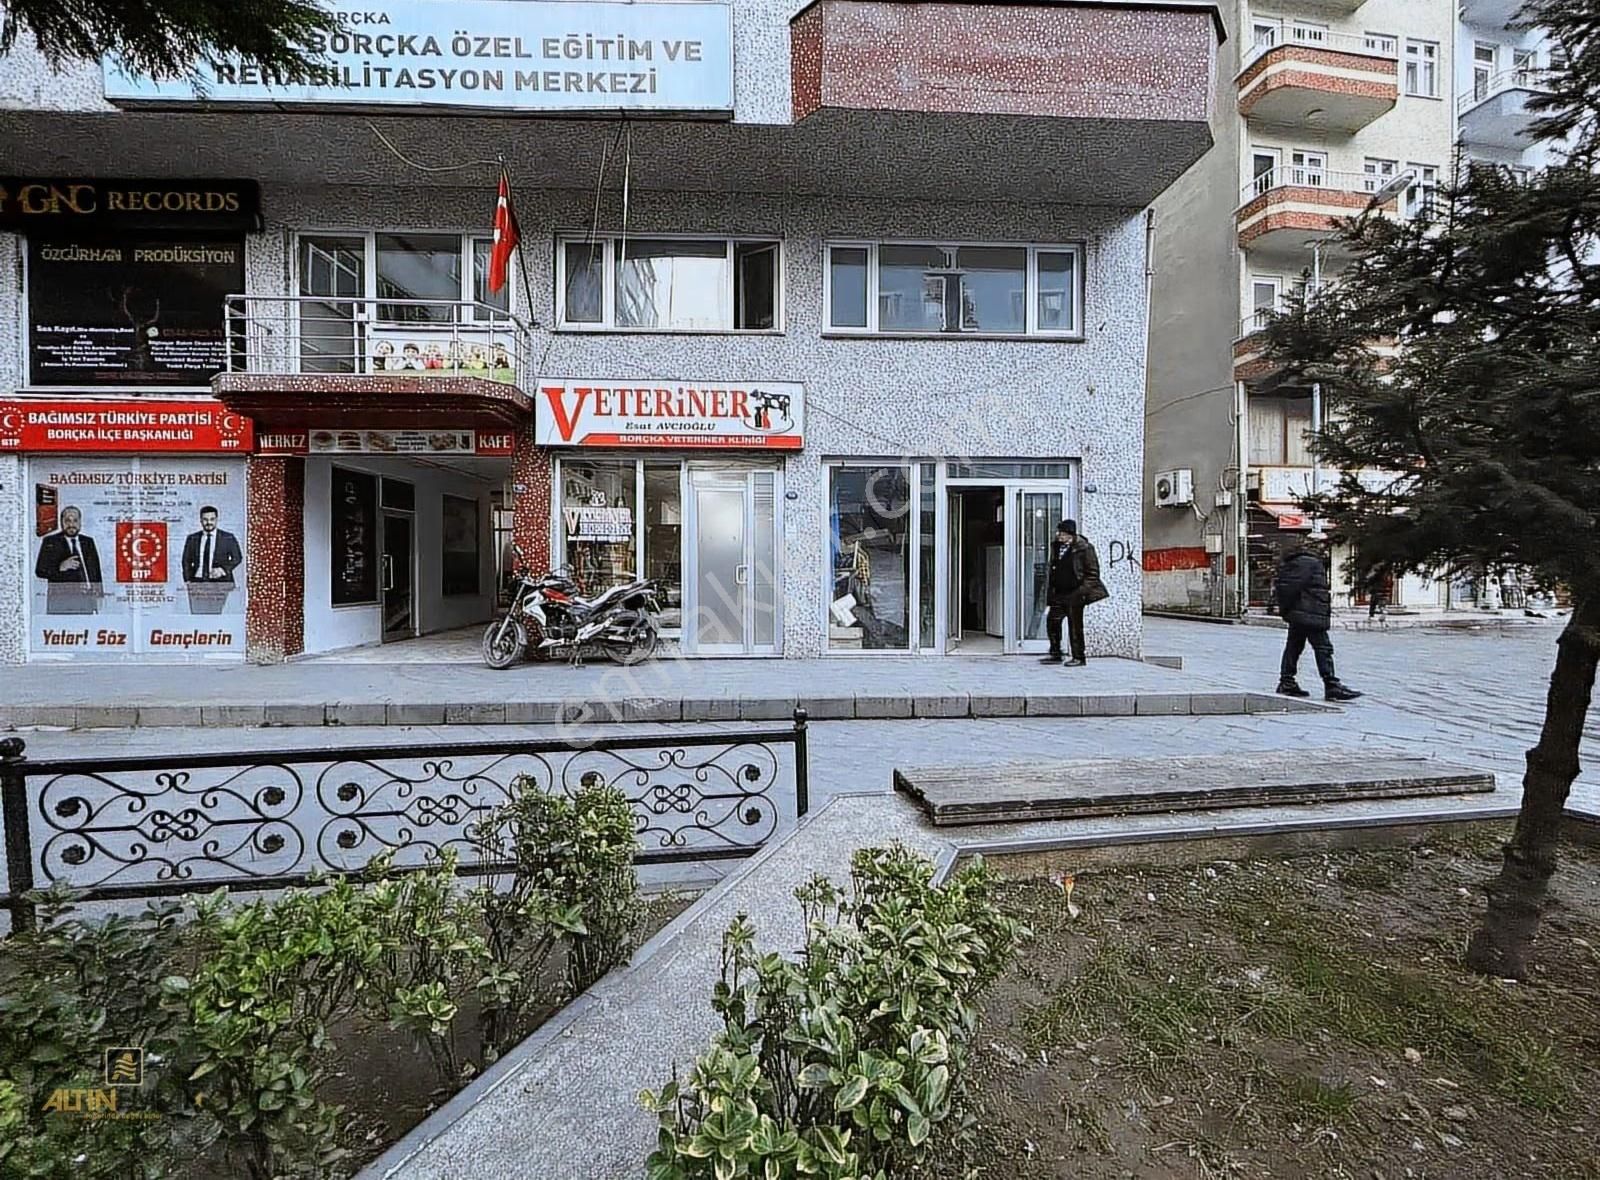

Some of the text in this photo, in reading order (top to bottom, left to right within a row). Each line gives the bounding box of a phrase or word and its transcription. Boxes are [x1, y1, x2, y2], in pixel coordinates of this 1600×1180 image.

[308, 30, 702, 61] BORÇKA ÖZEL EĞİTİM VE
[514, 68, 657, 94] MERKEZİ
[107, 191, 240, 211] RECORDS
[41, 244, 235, 263] ÖZGÜRHAN PRODÜKSİYON
[28, 410, 212, 425] BAĞIMSIZ TÜRKİYE PARTİSİ
[656, 421, 716, 431] AVCIOĞLU
[47, 427, 193, 442] BORÇKA İLÇE BAŞKANLIĞI
[479, 434, 511, 449] KAFE
[49, 471, 227, 485] BAĞIMSIZ TÜRKİYE PARTİSİ
[43, 629, 232, 649] Yeter! Söz Gençlerin
